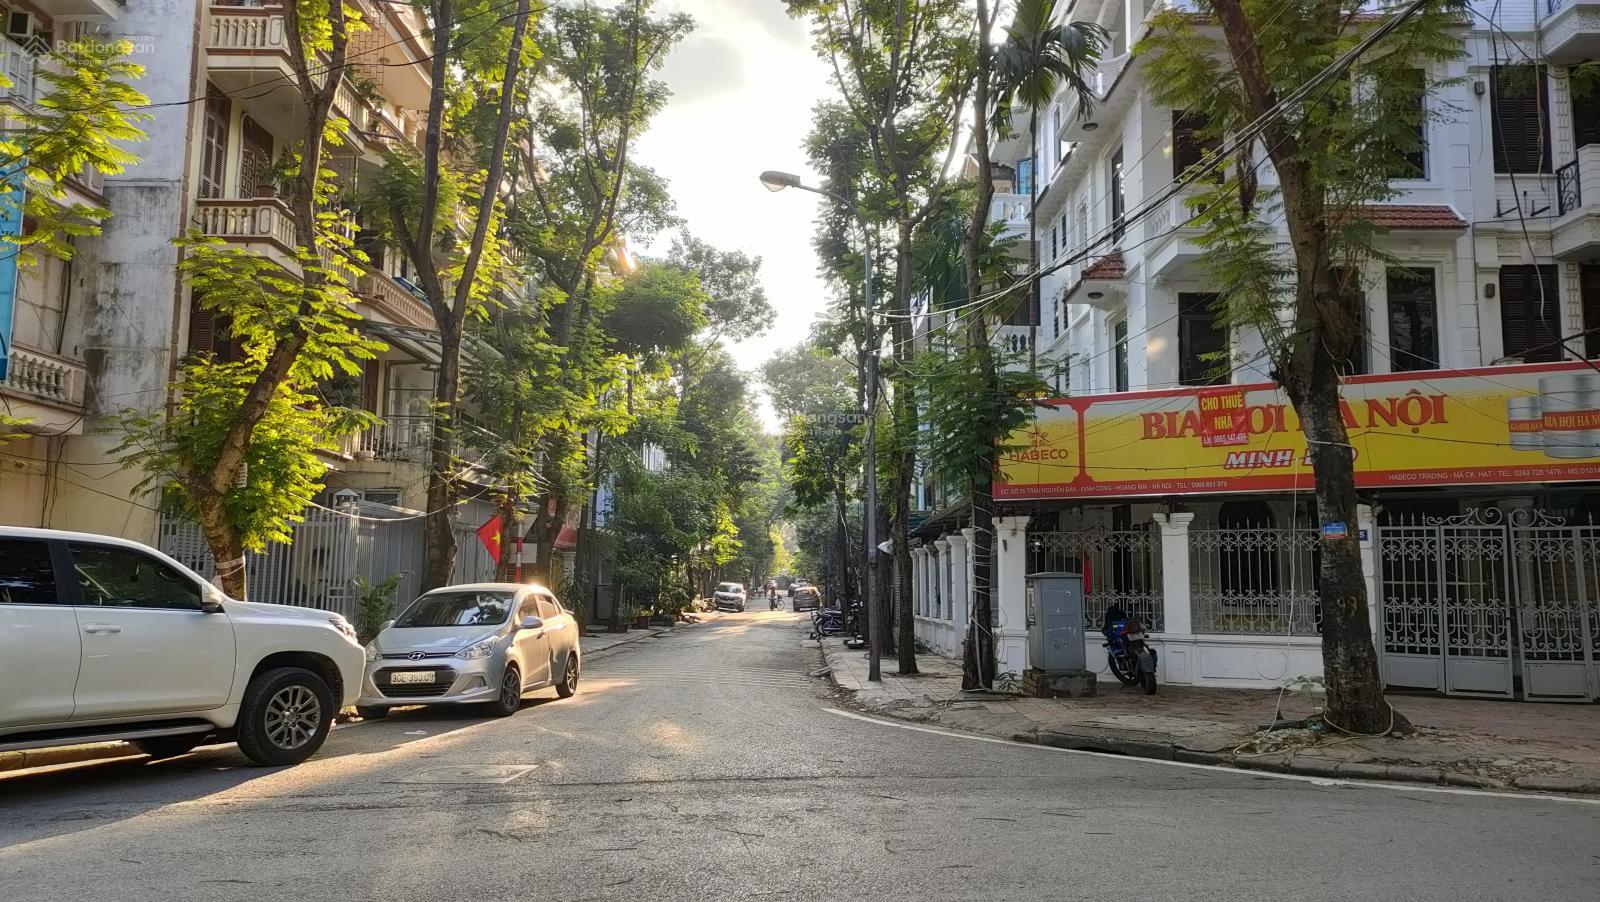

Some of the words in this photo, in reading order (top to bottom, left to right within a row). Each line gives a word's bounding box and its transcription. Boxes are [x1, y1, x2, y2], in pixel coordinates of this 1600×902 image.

[1201, 396, 1219, 411] CHO
[1220, 391, 1244, 409] THUÊ
[1141, 409, 1201, 440] BIA
[1246, 404, 1288, 435] ƠI
[1364, 388, 1448, 434] NỘI
[1214, 412, 1233, 430] NHÀ
[1544, 416, 1557, 427] BIA
[1009, 448, 1069, 461] HABECO
[1223, 448, 1295, 469] MINH
[1388, 473, 1417, 481] HABECO
[1418, 472, 1448, 480] TRADING
[1478, 470, 1492, 478] HAT
